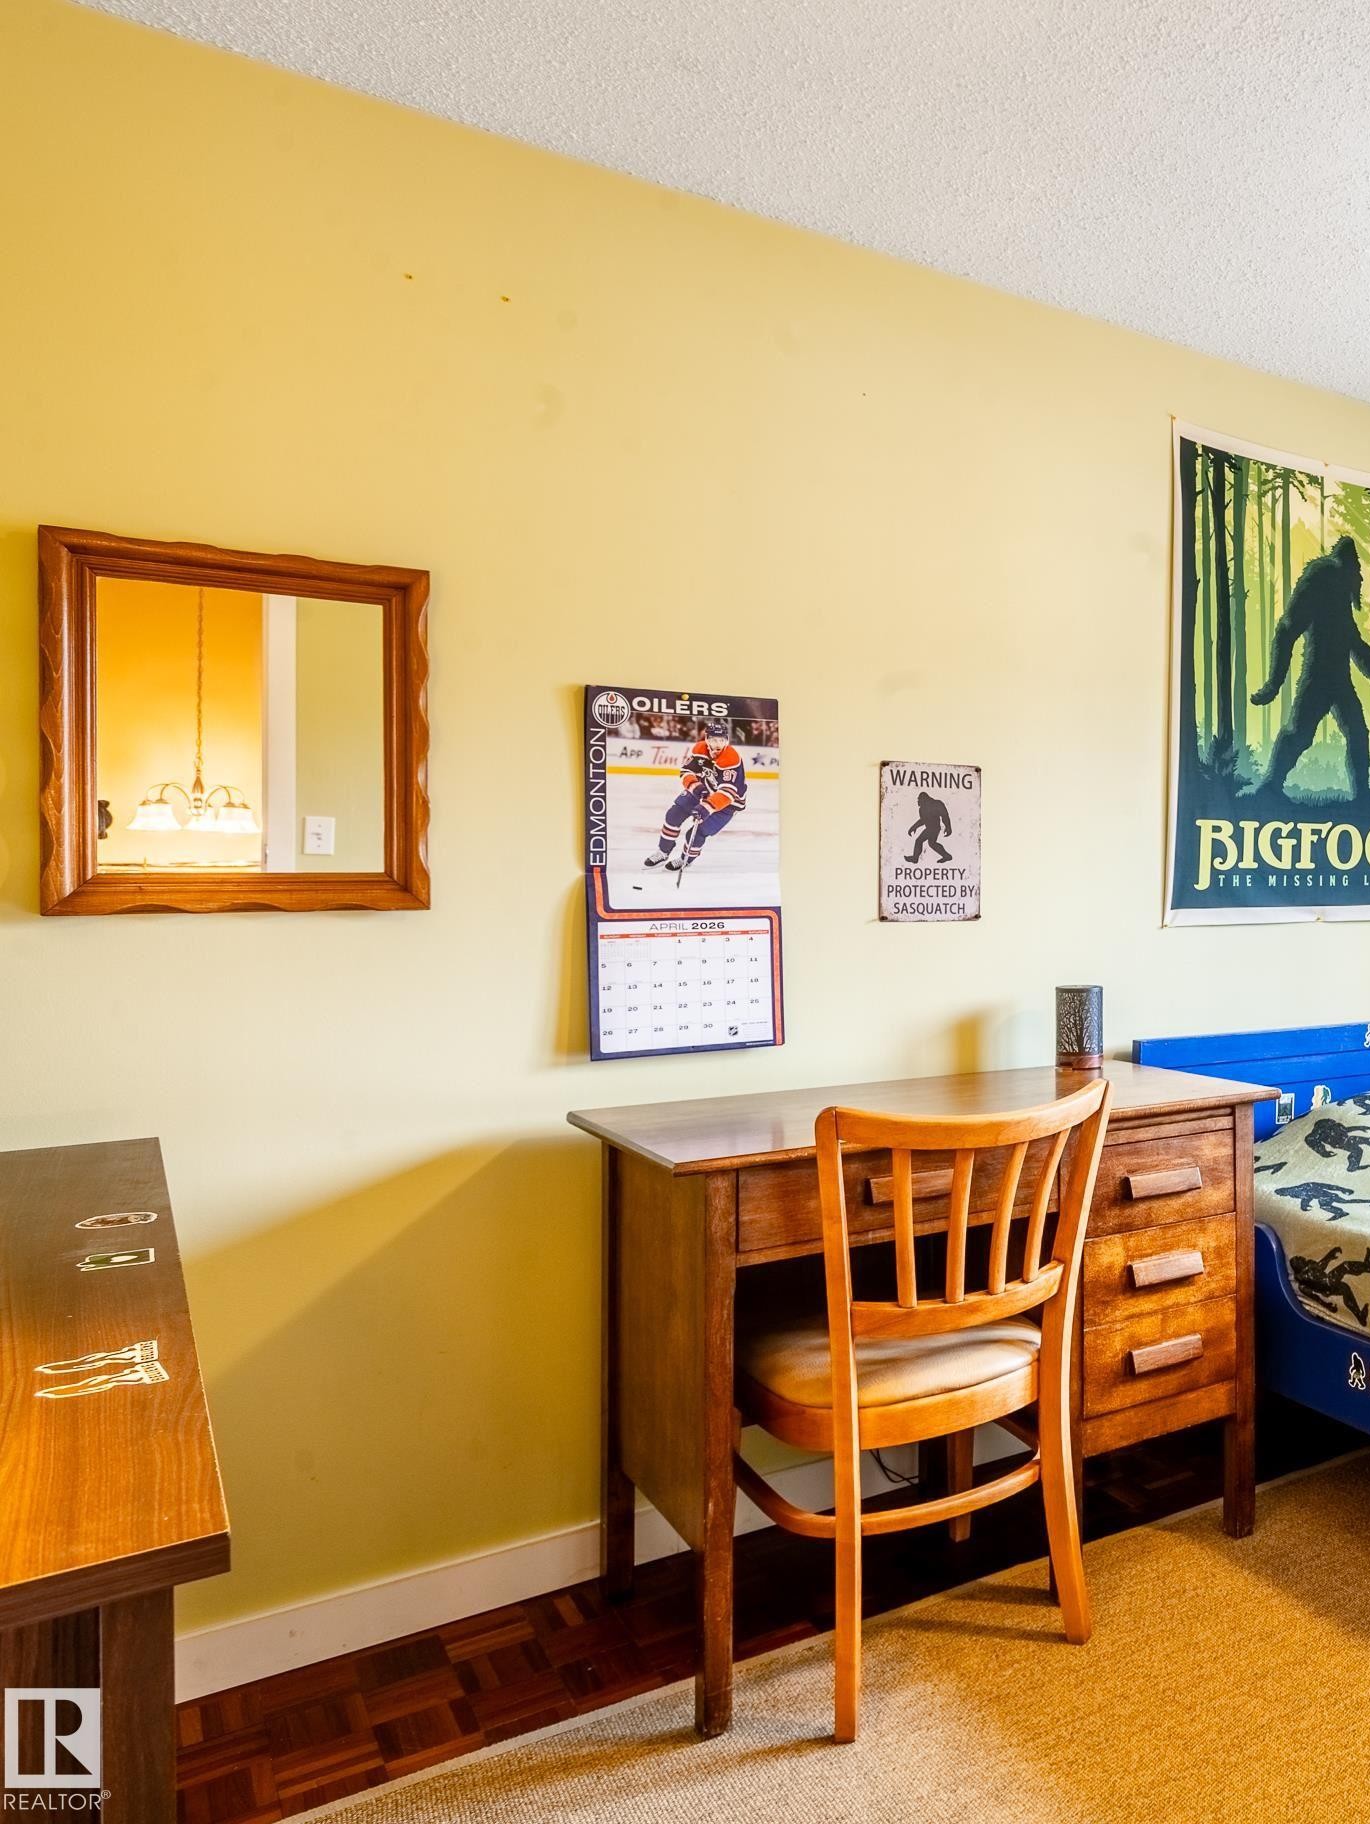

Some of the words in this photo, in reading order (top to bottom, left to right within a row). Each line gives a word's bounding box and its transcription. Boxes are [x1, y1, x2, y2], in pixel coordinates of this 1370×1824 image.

[632, 696, 729, 717] OILERS
[890, 769, 973, 790] WARNING
[590, 728, 606, 866] EDMONTON
[895, 867, 966, 881] PROPERTY
[1218, 874, 1252, 887] THE
[1268, 874, 1349, 887] MISSING
[887, 885, 956, 898] PROTECTED
[960, 885, 975, 898] BY
[893, 902, 965, 915] SASQUATCH
[649, 922, 688, 931] APRIL
[691, 922, 725, 930] 2026
